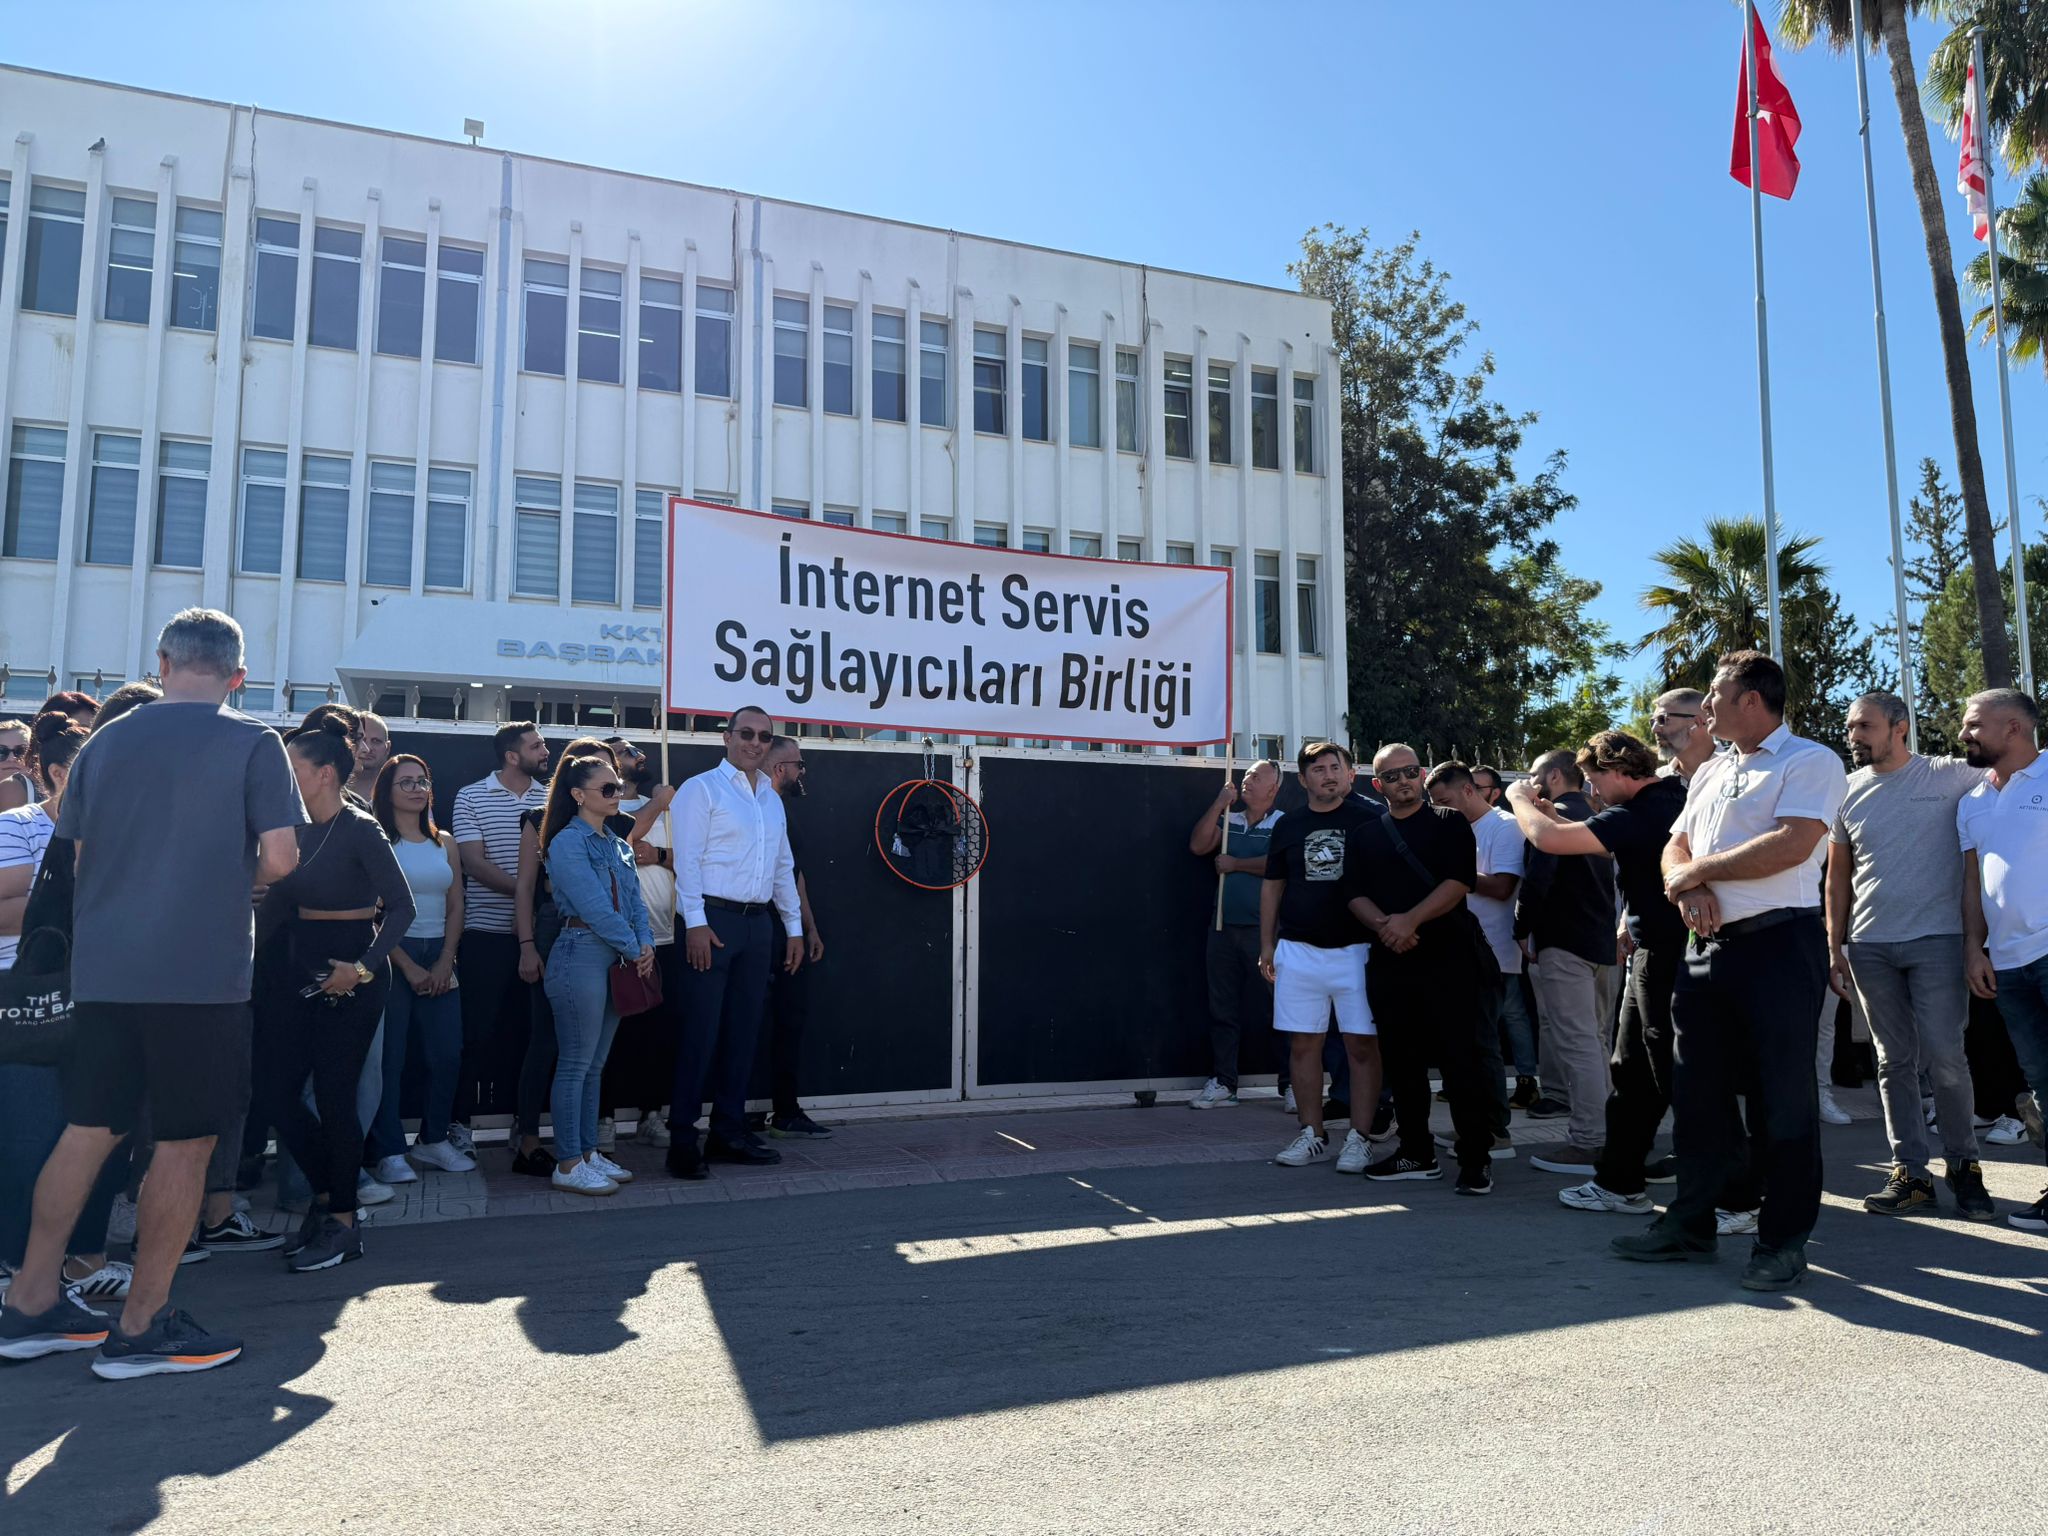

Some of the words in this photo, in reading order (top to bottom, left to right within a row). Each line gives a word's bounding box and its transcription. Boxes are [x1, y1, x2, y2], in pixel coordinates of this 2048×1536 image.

[778, 532, 986, 626] İnternet
[1001, 573, 1150, 639] Servis
[713, 620, 1043, 710] Sağlayıcıları
[1058, 652, 1192, 729] Birliği
[26, 990, 62, 1007] THE
